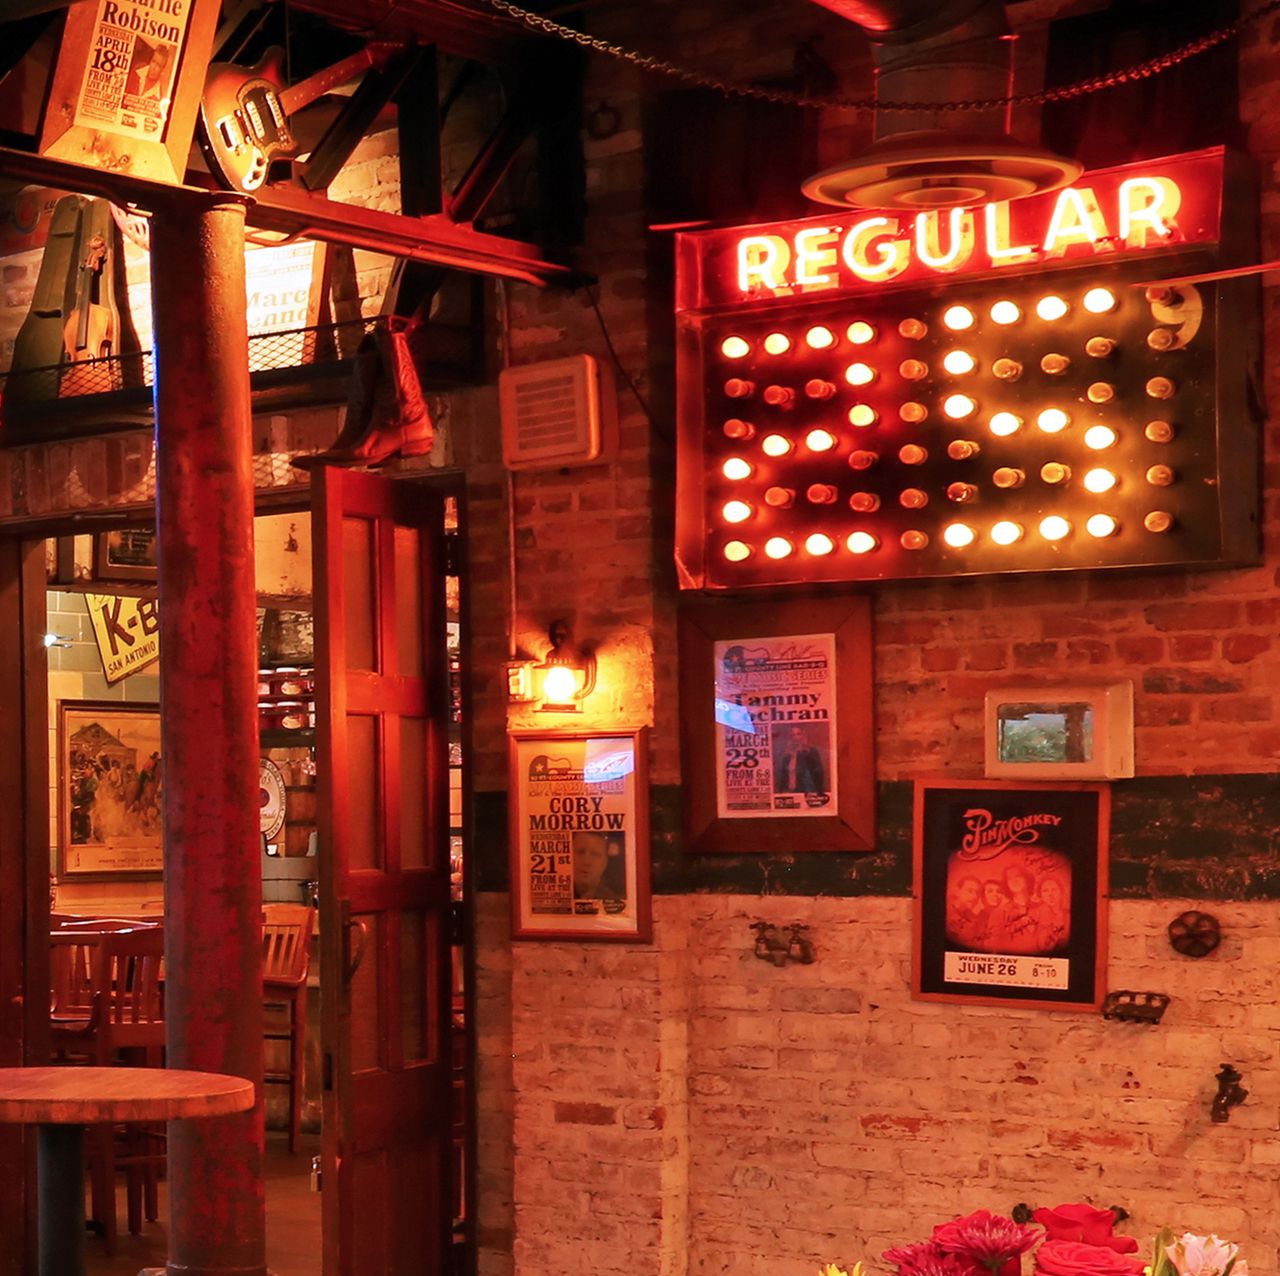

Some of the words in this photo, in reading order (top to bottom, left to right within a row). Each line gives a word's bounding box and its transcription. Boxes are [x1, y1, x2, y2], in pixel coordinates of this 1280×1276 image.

[102, 0, 180, 43] Robison
[96, 35, 131, 55] APRIL
[91, 48, 128, 73] 18th
[738, 176, 1182, 298] REGULAR
[108, 659, 124, 675] SAN
[125, 640, 156, 665] ANTONIO
[730, 692, 821, 707] Tammy
[725, 706, 829, 722] Cochran
[725, 733, 769, 748] MARCH
[726, 748, 770, 769] 28th
[726, 769, 753, 780] FROM
[549, 796, 604, 814] CORY
[529, 813, 625, 831] MORROW
[530, 841, 571, 854] MARCH
[530, 854, 571, 874] 21st
[531, 874, 557, 885] FROM
[958, 955, 1019, 964] WEDNESDAY
[958, 962, 995, 976] JUNE
[997, 964, 1017, 976] 26
[1032, 967, 1058, 978] 8-10
